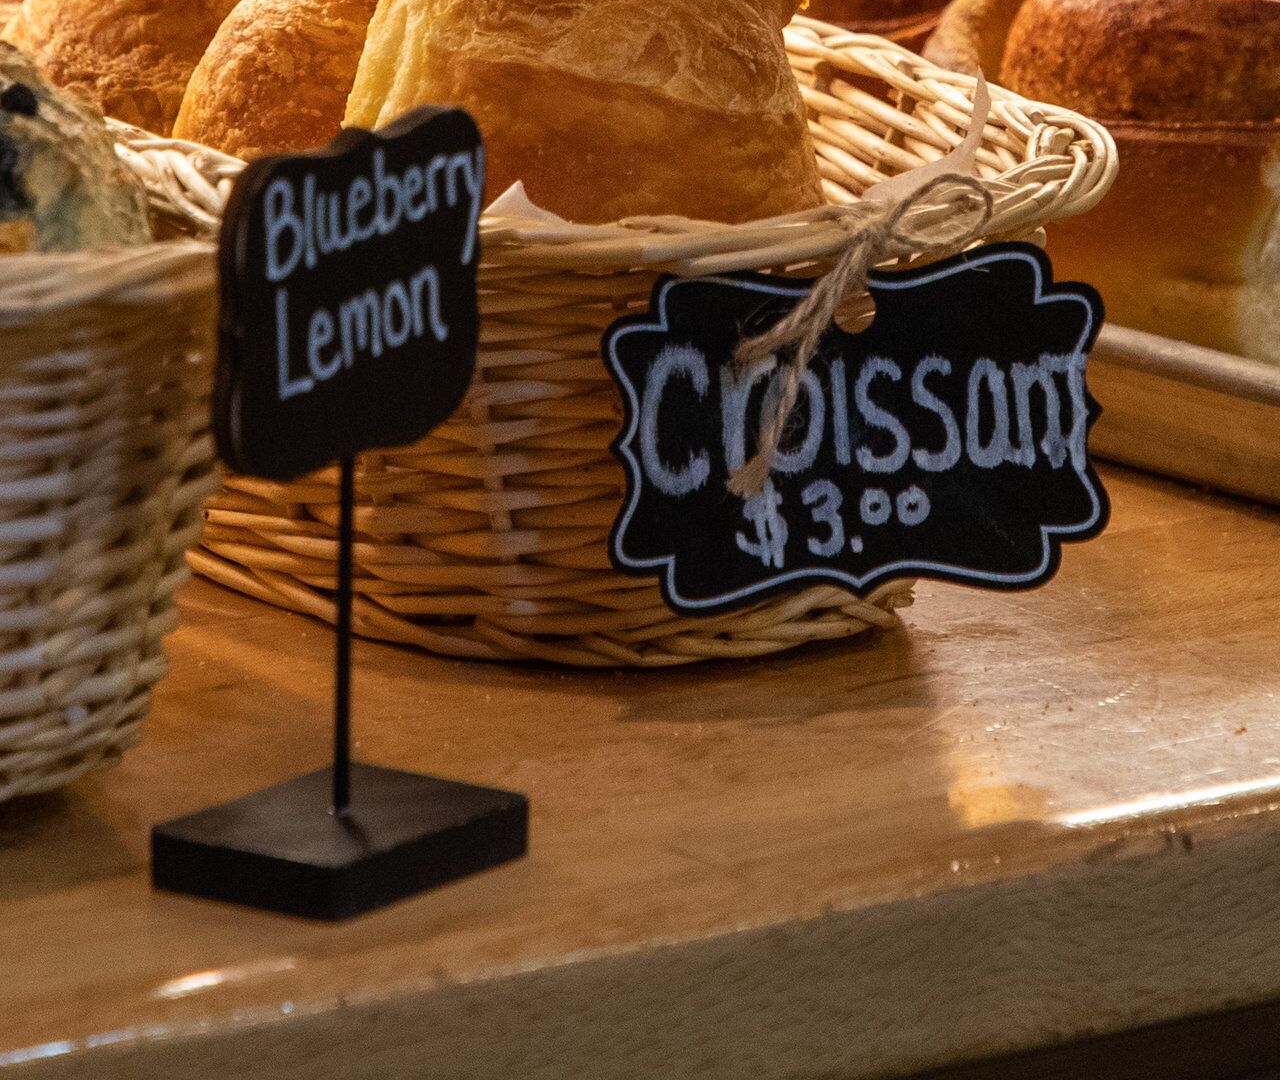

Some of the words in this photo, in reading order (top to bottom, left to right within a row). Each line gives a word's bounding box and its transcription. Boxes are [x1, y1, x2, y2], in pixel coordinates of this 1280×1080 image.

[264, 146, 486, 282] Blueberry
[275, 265, 448, 400] Lemon
[736, 479, 932, 568] $3.00
